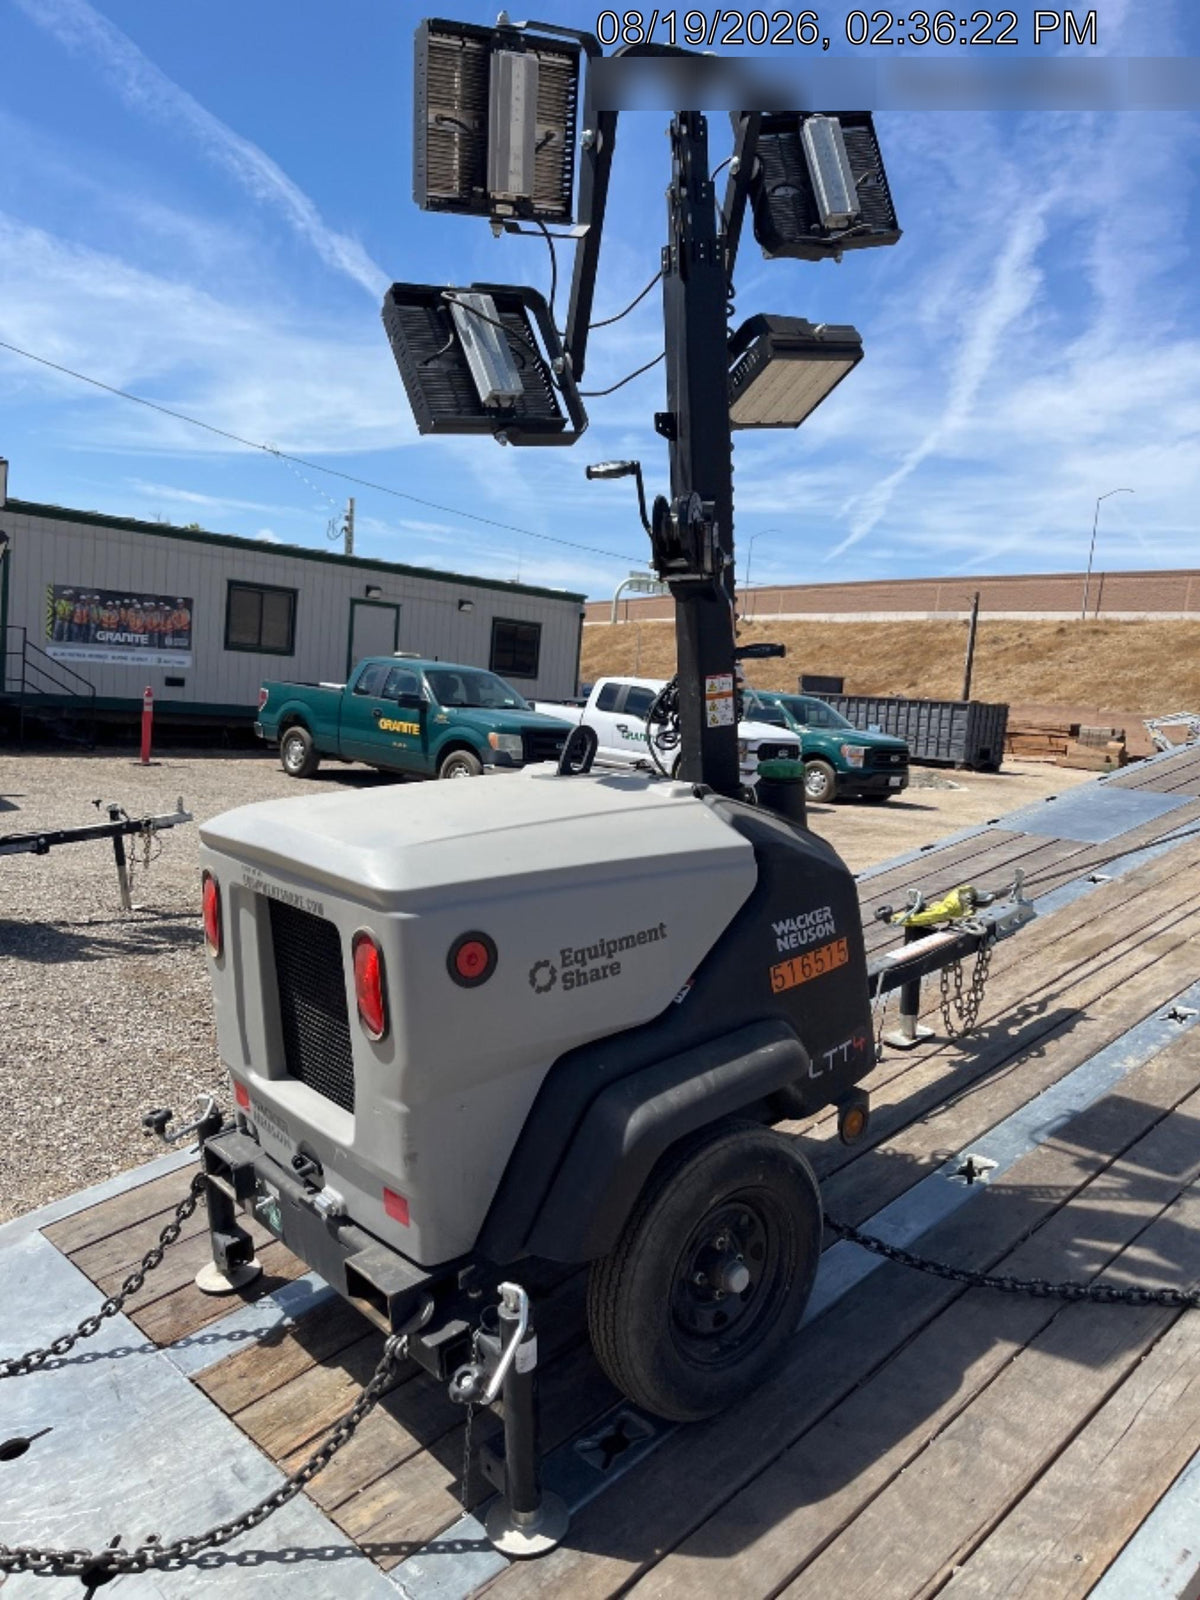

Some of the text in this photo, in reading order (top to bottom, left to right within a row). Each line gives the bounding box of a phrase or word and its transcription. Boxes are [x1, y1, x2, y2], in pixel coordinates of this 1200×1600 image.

[96, 630, 149, 644] GRANITE
[378, 718, 420, 735] GRANITE
[771, 906, 832, 936] WACKER
[775, 920, 836, 952] NEUSON
[560, 922, 667, 968] Equipment
[562, 960, 621, 991] Share
[772, 940, 848, 989] 516515
